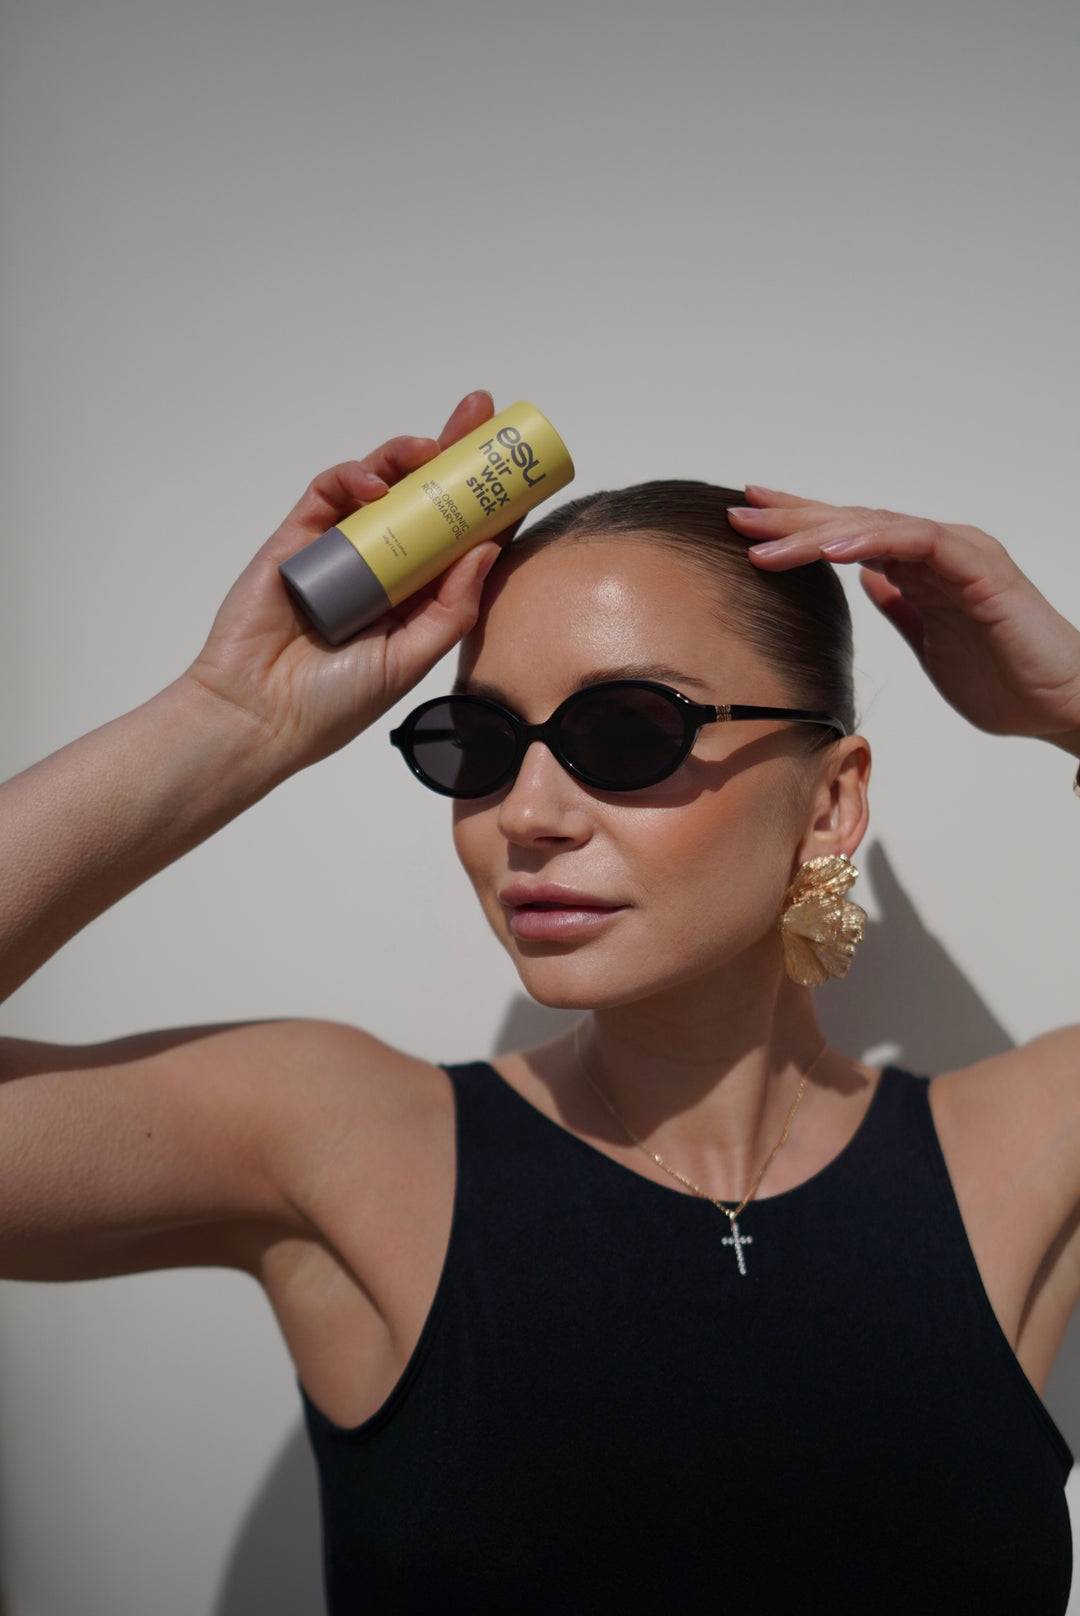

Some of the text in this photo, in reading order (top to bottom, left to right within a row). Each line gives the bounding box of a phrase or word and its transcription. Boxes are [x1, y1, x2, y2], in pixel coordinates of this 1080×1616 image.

[478, 438, 512, 475] hair
[497, 427, 547, 488] esu
[466, 476, 497, 516] stick
[481, 465, 510, 507] wax
[422, 483, 464, 540] ROSEMARY OIL
[442, 494, 470, 532] ORGANIC
